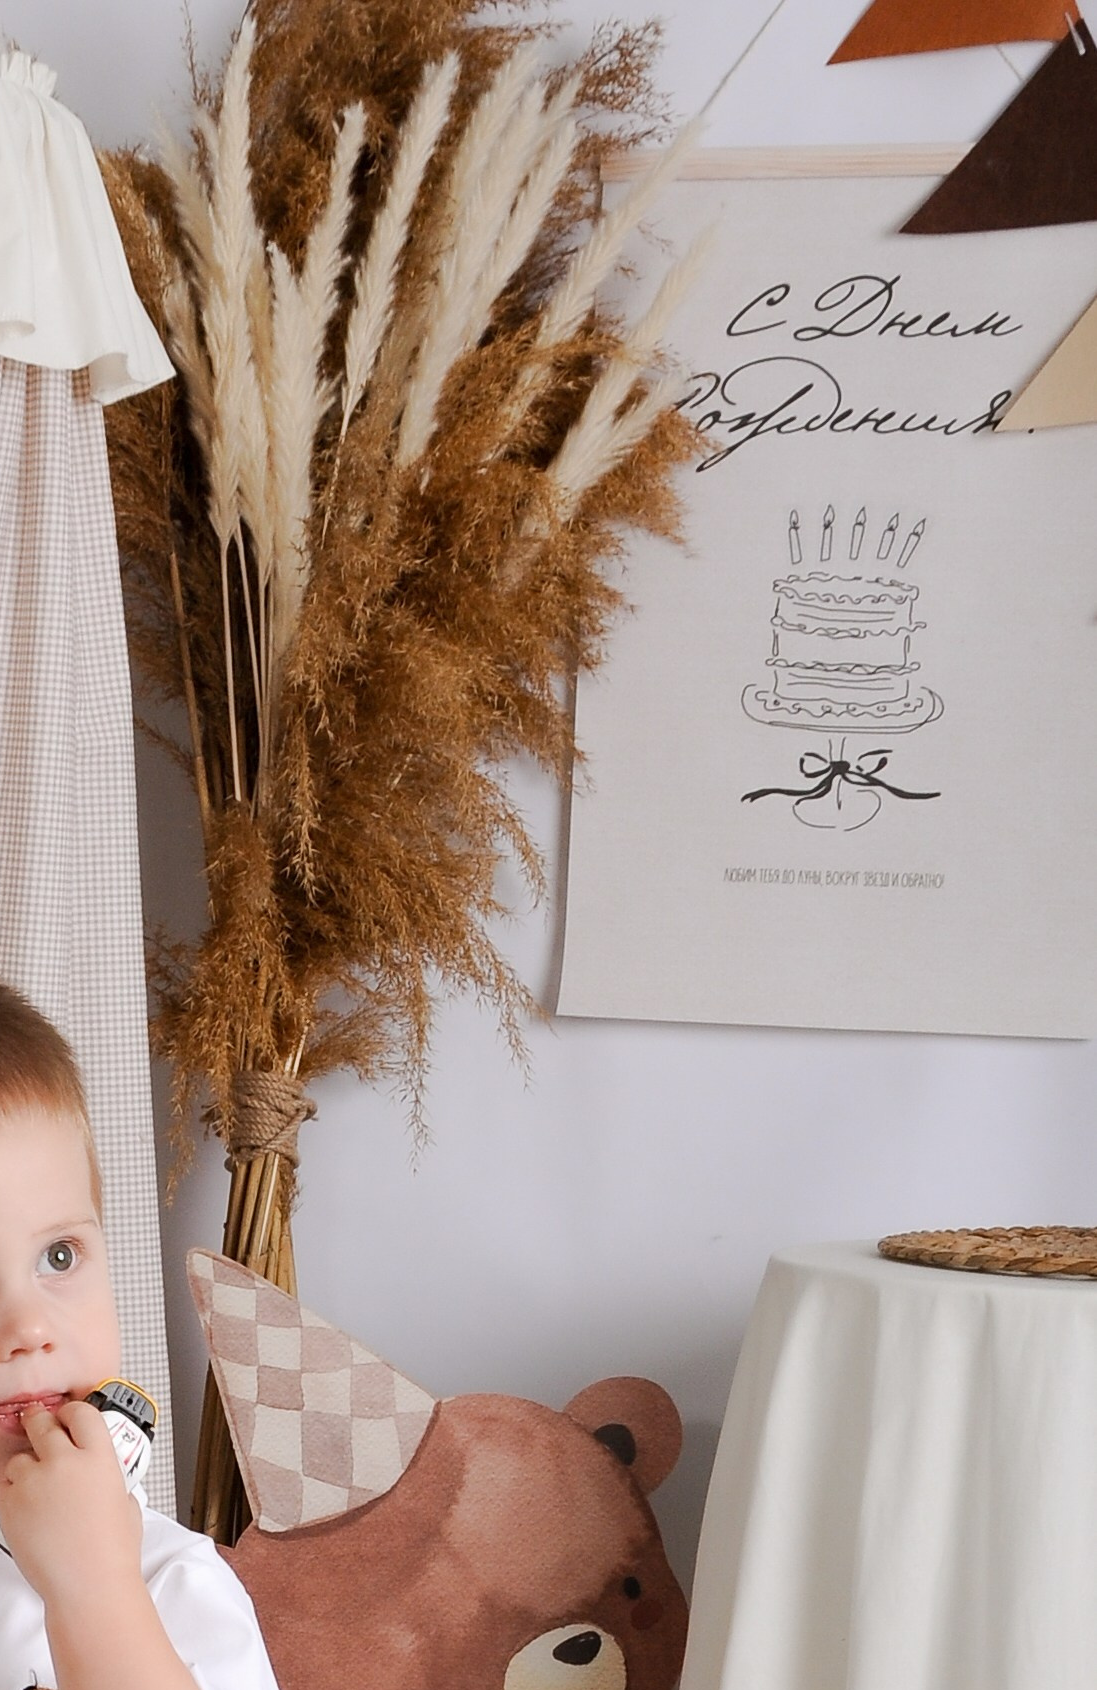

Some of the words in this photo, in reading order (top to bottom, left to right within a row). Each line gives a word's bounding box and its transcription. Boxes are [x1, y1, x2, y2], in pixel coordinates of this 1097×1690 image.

[727, 283, 790, 337] С
[794, 275, 1023, 342] Днем
[723, 867, 757, 882] ЛЮБИМ
[759, 868, 780, 884] ТЕБЯ
[781, 869, 795, 884] ДО
[825, 870, 860, 886] ВОКРУГ
[862, 871, 890, 888] ЗВЕЗД
[891, 872, 900, 887] И
